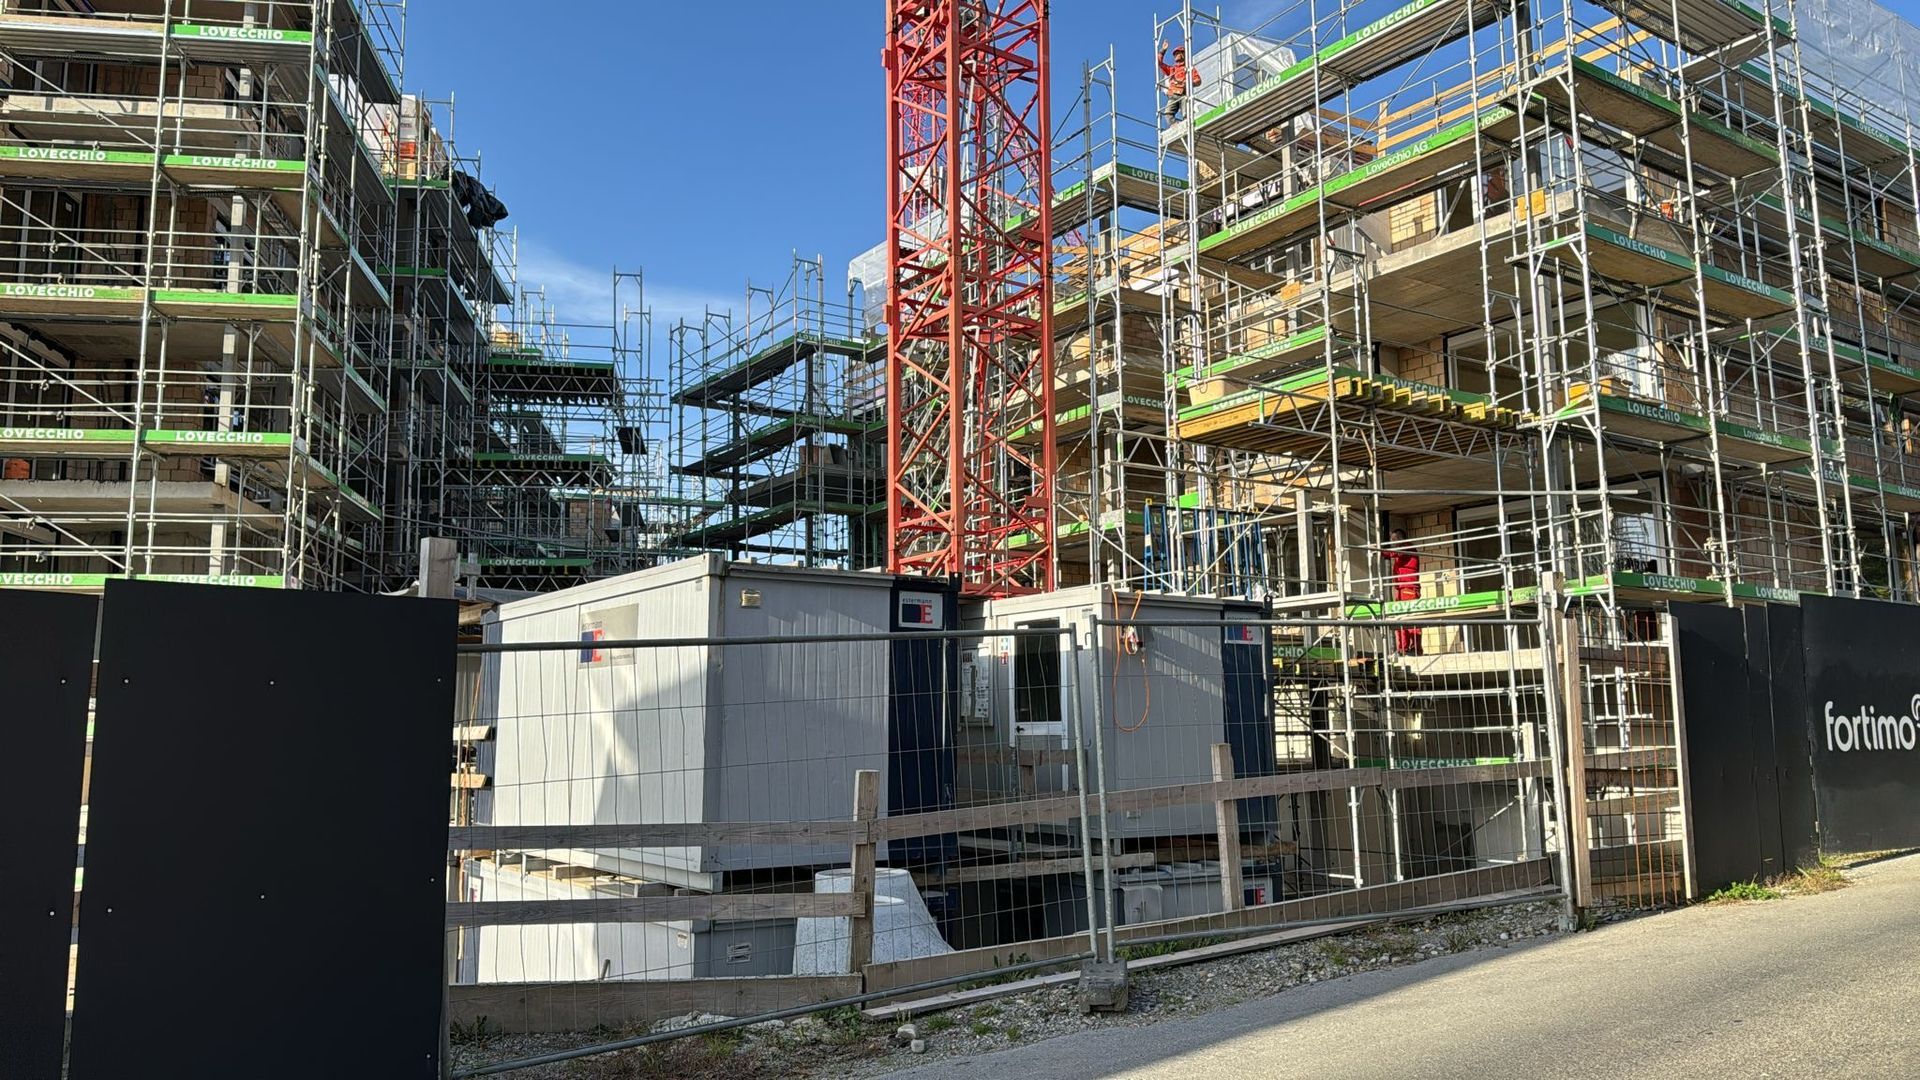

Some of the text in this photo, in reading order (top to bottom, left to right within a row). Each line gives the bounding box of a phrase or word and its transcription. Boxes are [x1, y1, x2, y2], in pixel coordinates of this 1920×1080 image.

[1356, 0, 1425, 40] LOVECCHIO
[200, 26, 283, 40] LOVECCHIO
[1225, 75, 1281, 111] LOVECCHIO
[19, 148, 106, 161] LOVECCHIO
[193, 156, 277, 169] LOVECCHIO
[1365, 140, 1429, 176] Lovecchio AG
[1229, 204, 1286, 236] LOVECCHIO
[1613, 234, 1667, 260] LOVECCHIO
[6, 285, 95, 297] LOVECCHIO
[1725, 272, 1771, 296] LOVECCHIO
[1123, 395, 1165, 411] LOVECCH
[1627, 402, 1680, 423] LOVECCHIO
[176, 431, 264, 443] LOVECCHIO
[0, 573, 73, 584] VECCHIO
[1643, 575, 1697, 590] LOVECCHIO
[1825, 701, 1915, 752] fortimo
